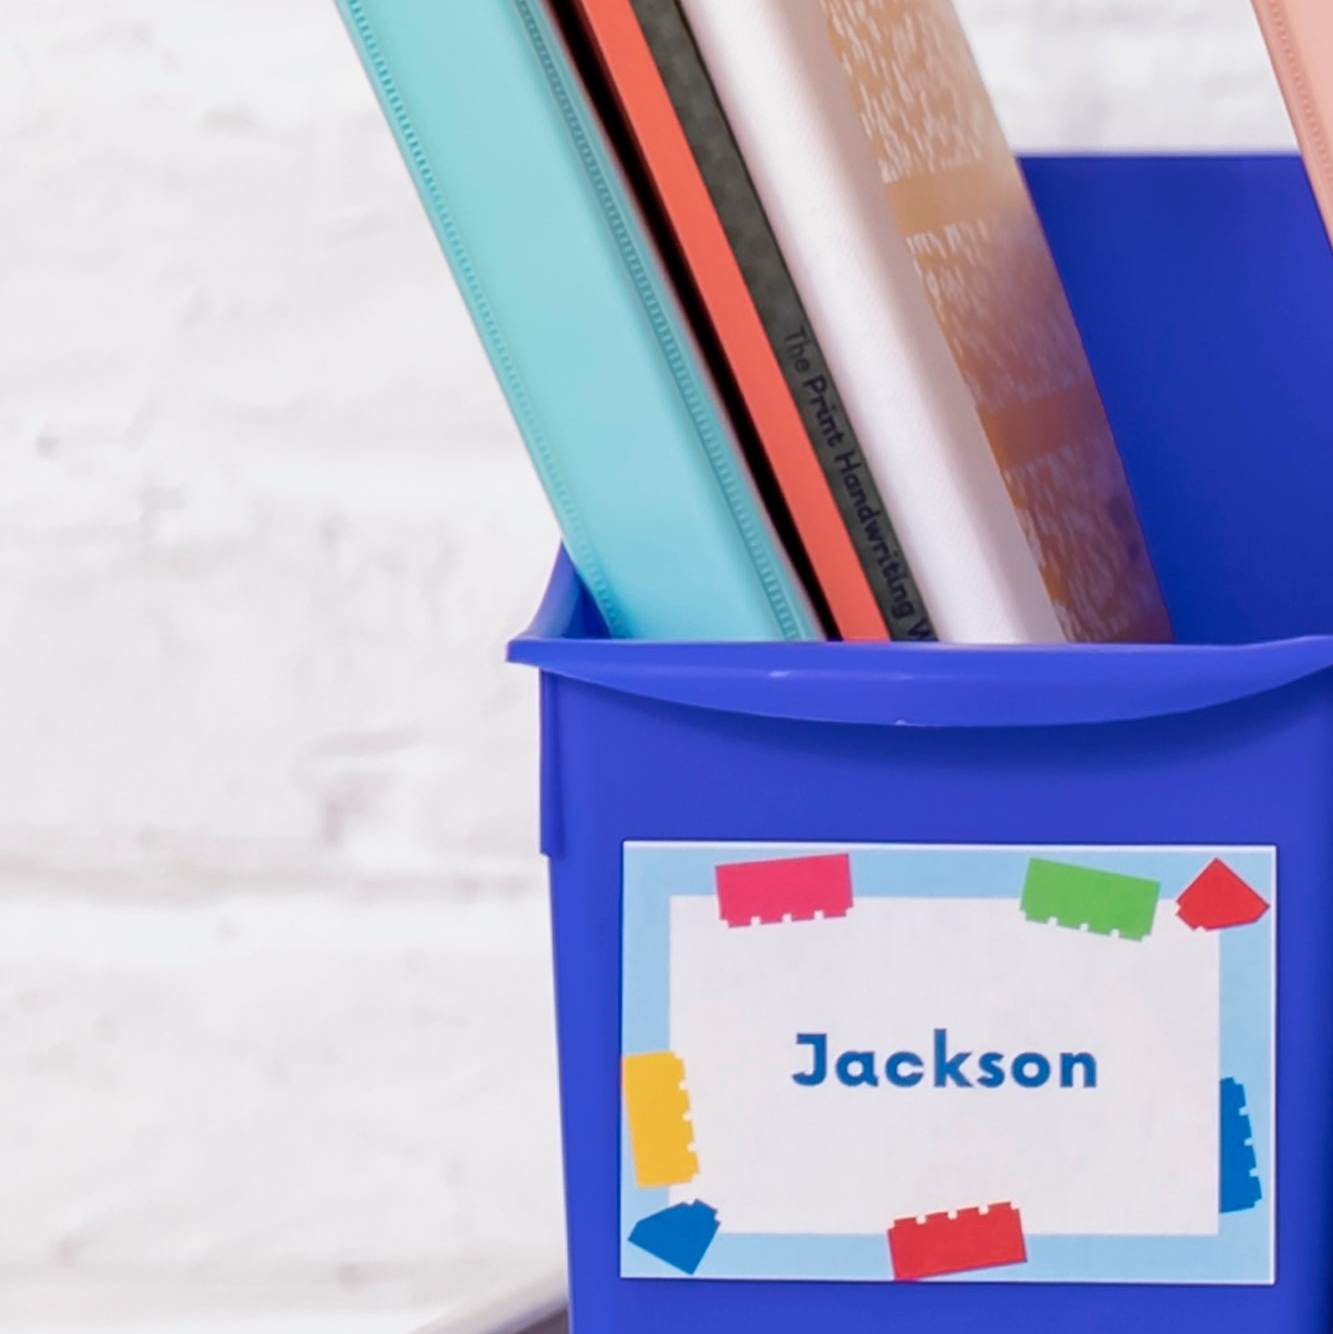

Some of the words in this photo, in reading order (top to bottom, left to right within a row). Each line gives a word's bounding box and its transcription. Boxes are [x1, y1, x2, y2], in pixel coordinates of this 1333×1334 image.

[784, 328, 811, 373] The
[803, 374, 845, 448] Print
[834, 450, 916, 621] Handwriting
[791, 1028, 1098, 1088] Jackson
